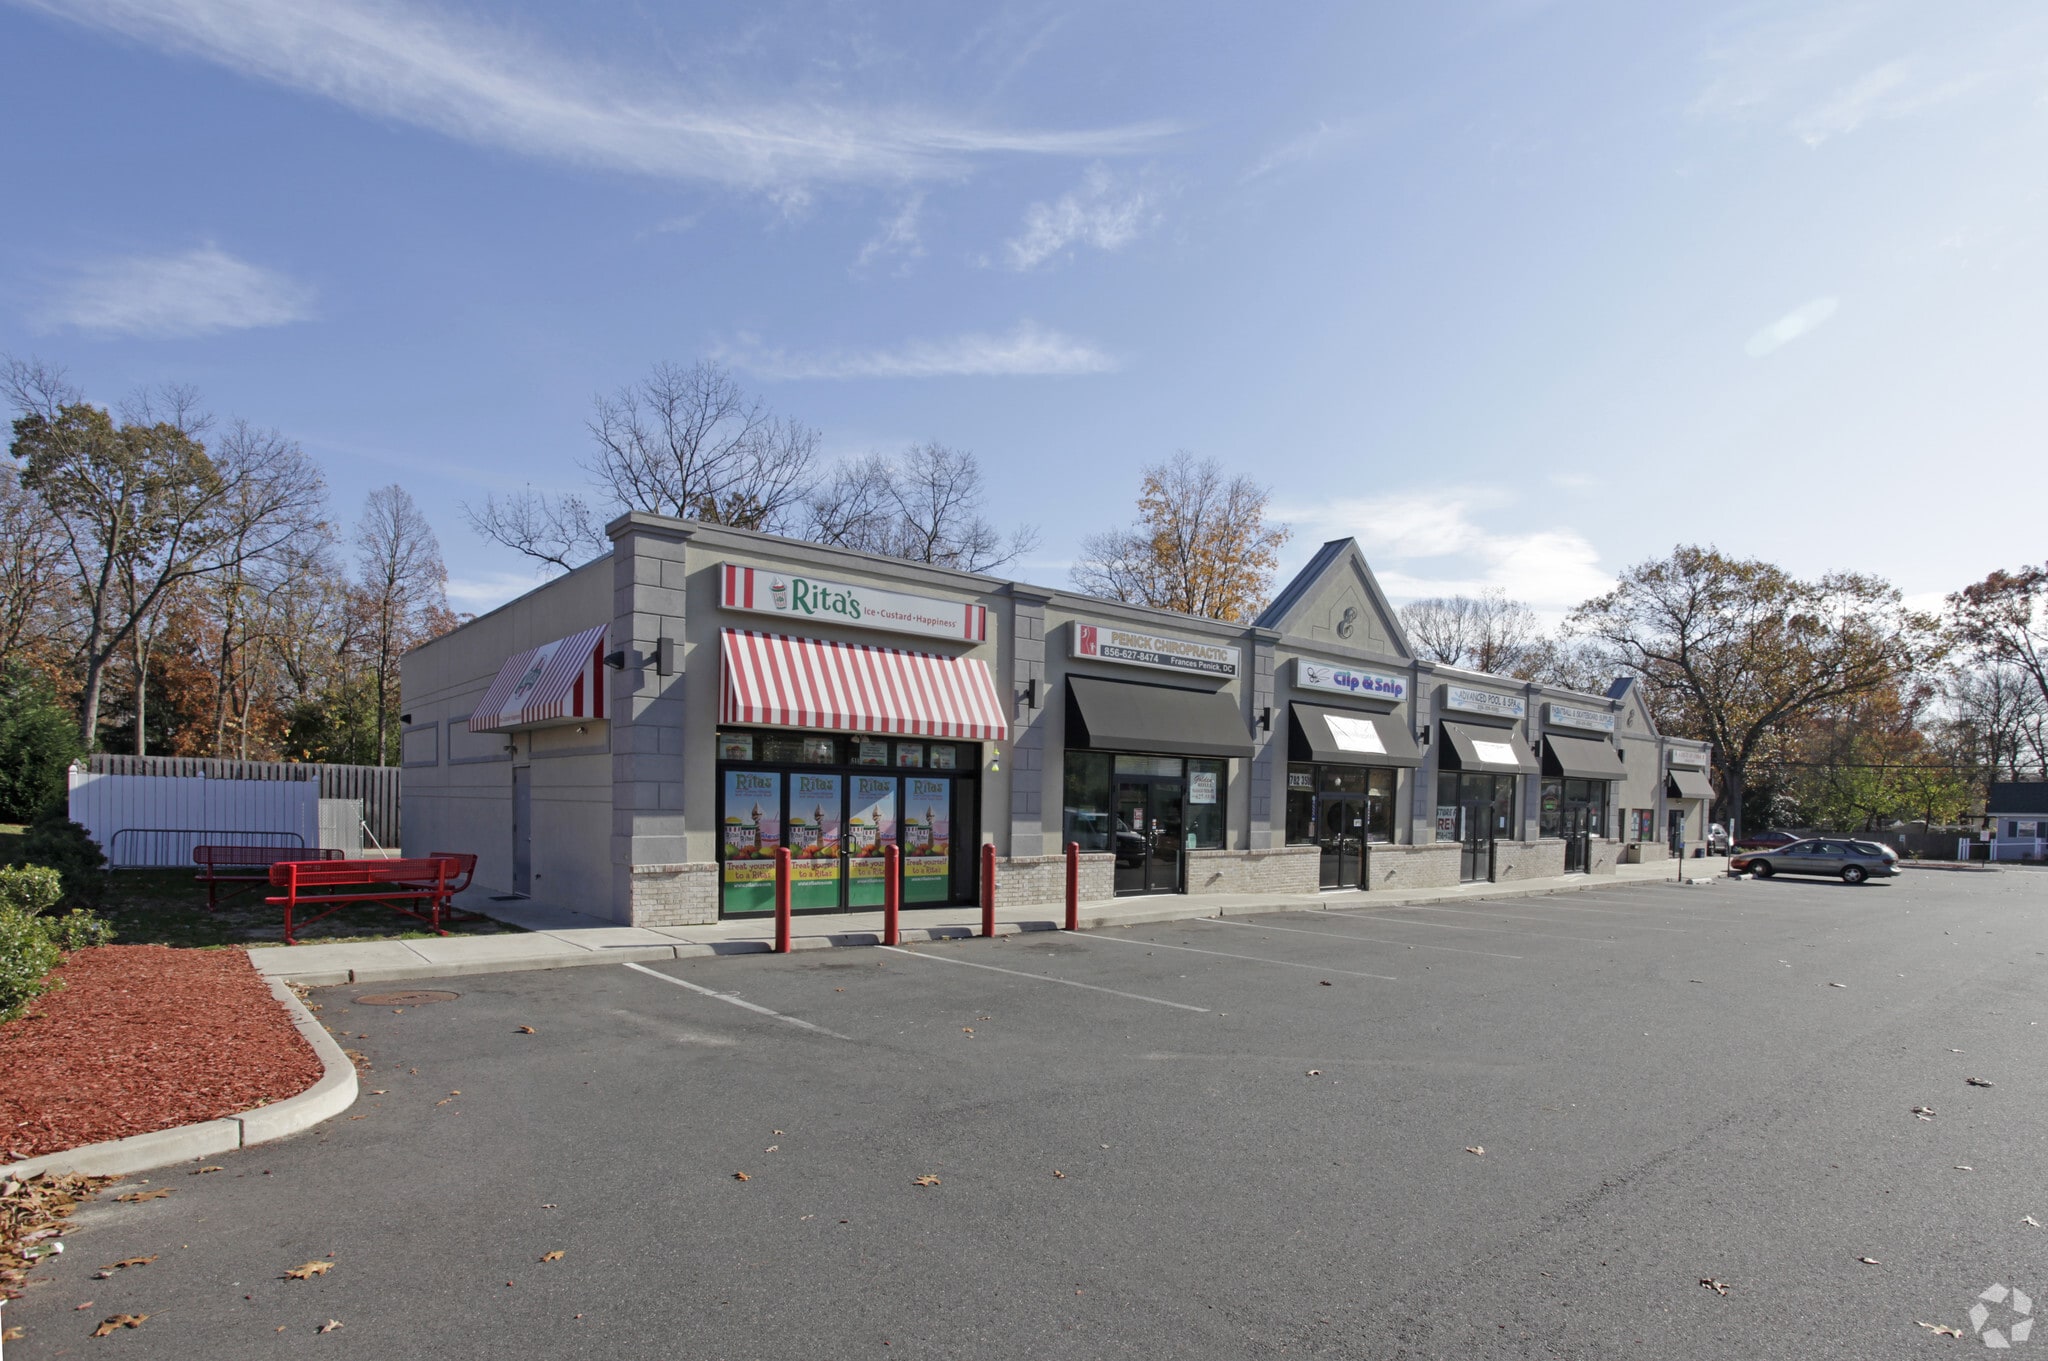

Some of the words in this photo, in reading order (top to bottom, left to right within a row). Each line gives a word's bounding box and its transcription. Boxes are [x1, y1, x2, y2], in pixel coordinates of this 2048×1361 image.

[791, 578, 862, 620] Rita's
[1111, 631, 1153, 650] PENICK
[1154, 639, 1228, 662] CHIROPRACTIC
[1104, 647, 1159, 663] 856-627-8474
[1170, 656, 1198, 668] Frances
[1198, 660, 1222, 672] Penick,
[1222, 664, 1233, 674] DC
[1333, 671, 1360, 691] Clip
[1362, 675, 1374, 691] &
[1374, 677, 1403, 698] Snip
[1458, 689, 1487, 704] ADVANCED
[1488, 694, 1502, 706] POOL
[1507, 698, 1518, 708] SPA
[727, 862, 747, 870] Treat
[791, 861, 810, 870] Treat
[852, 860, 869, 868] Treat
[735, 871, 744, 879] to
[799, 870, 807, 878] to
